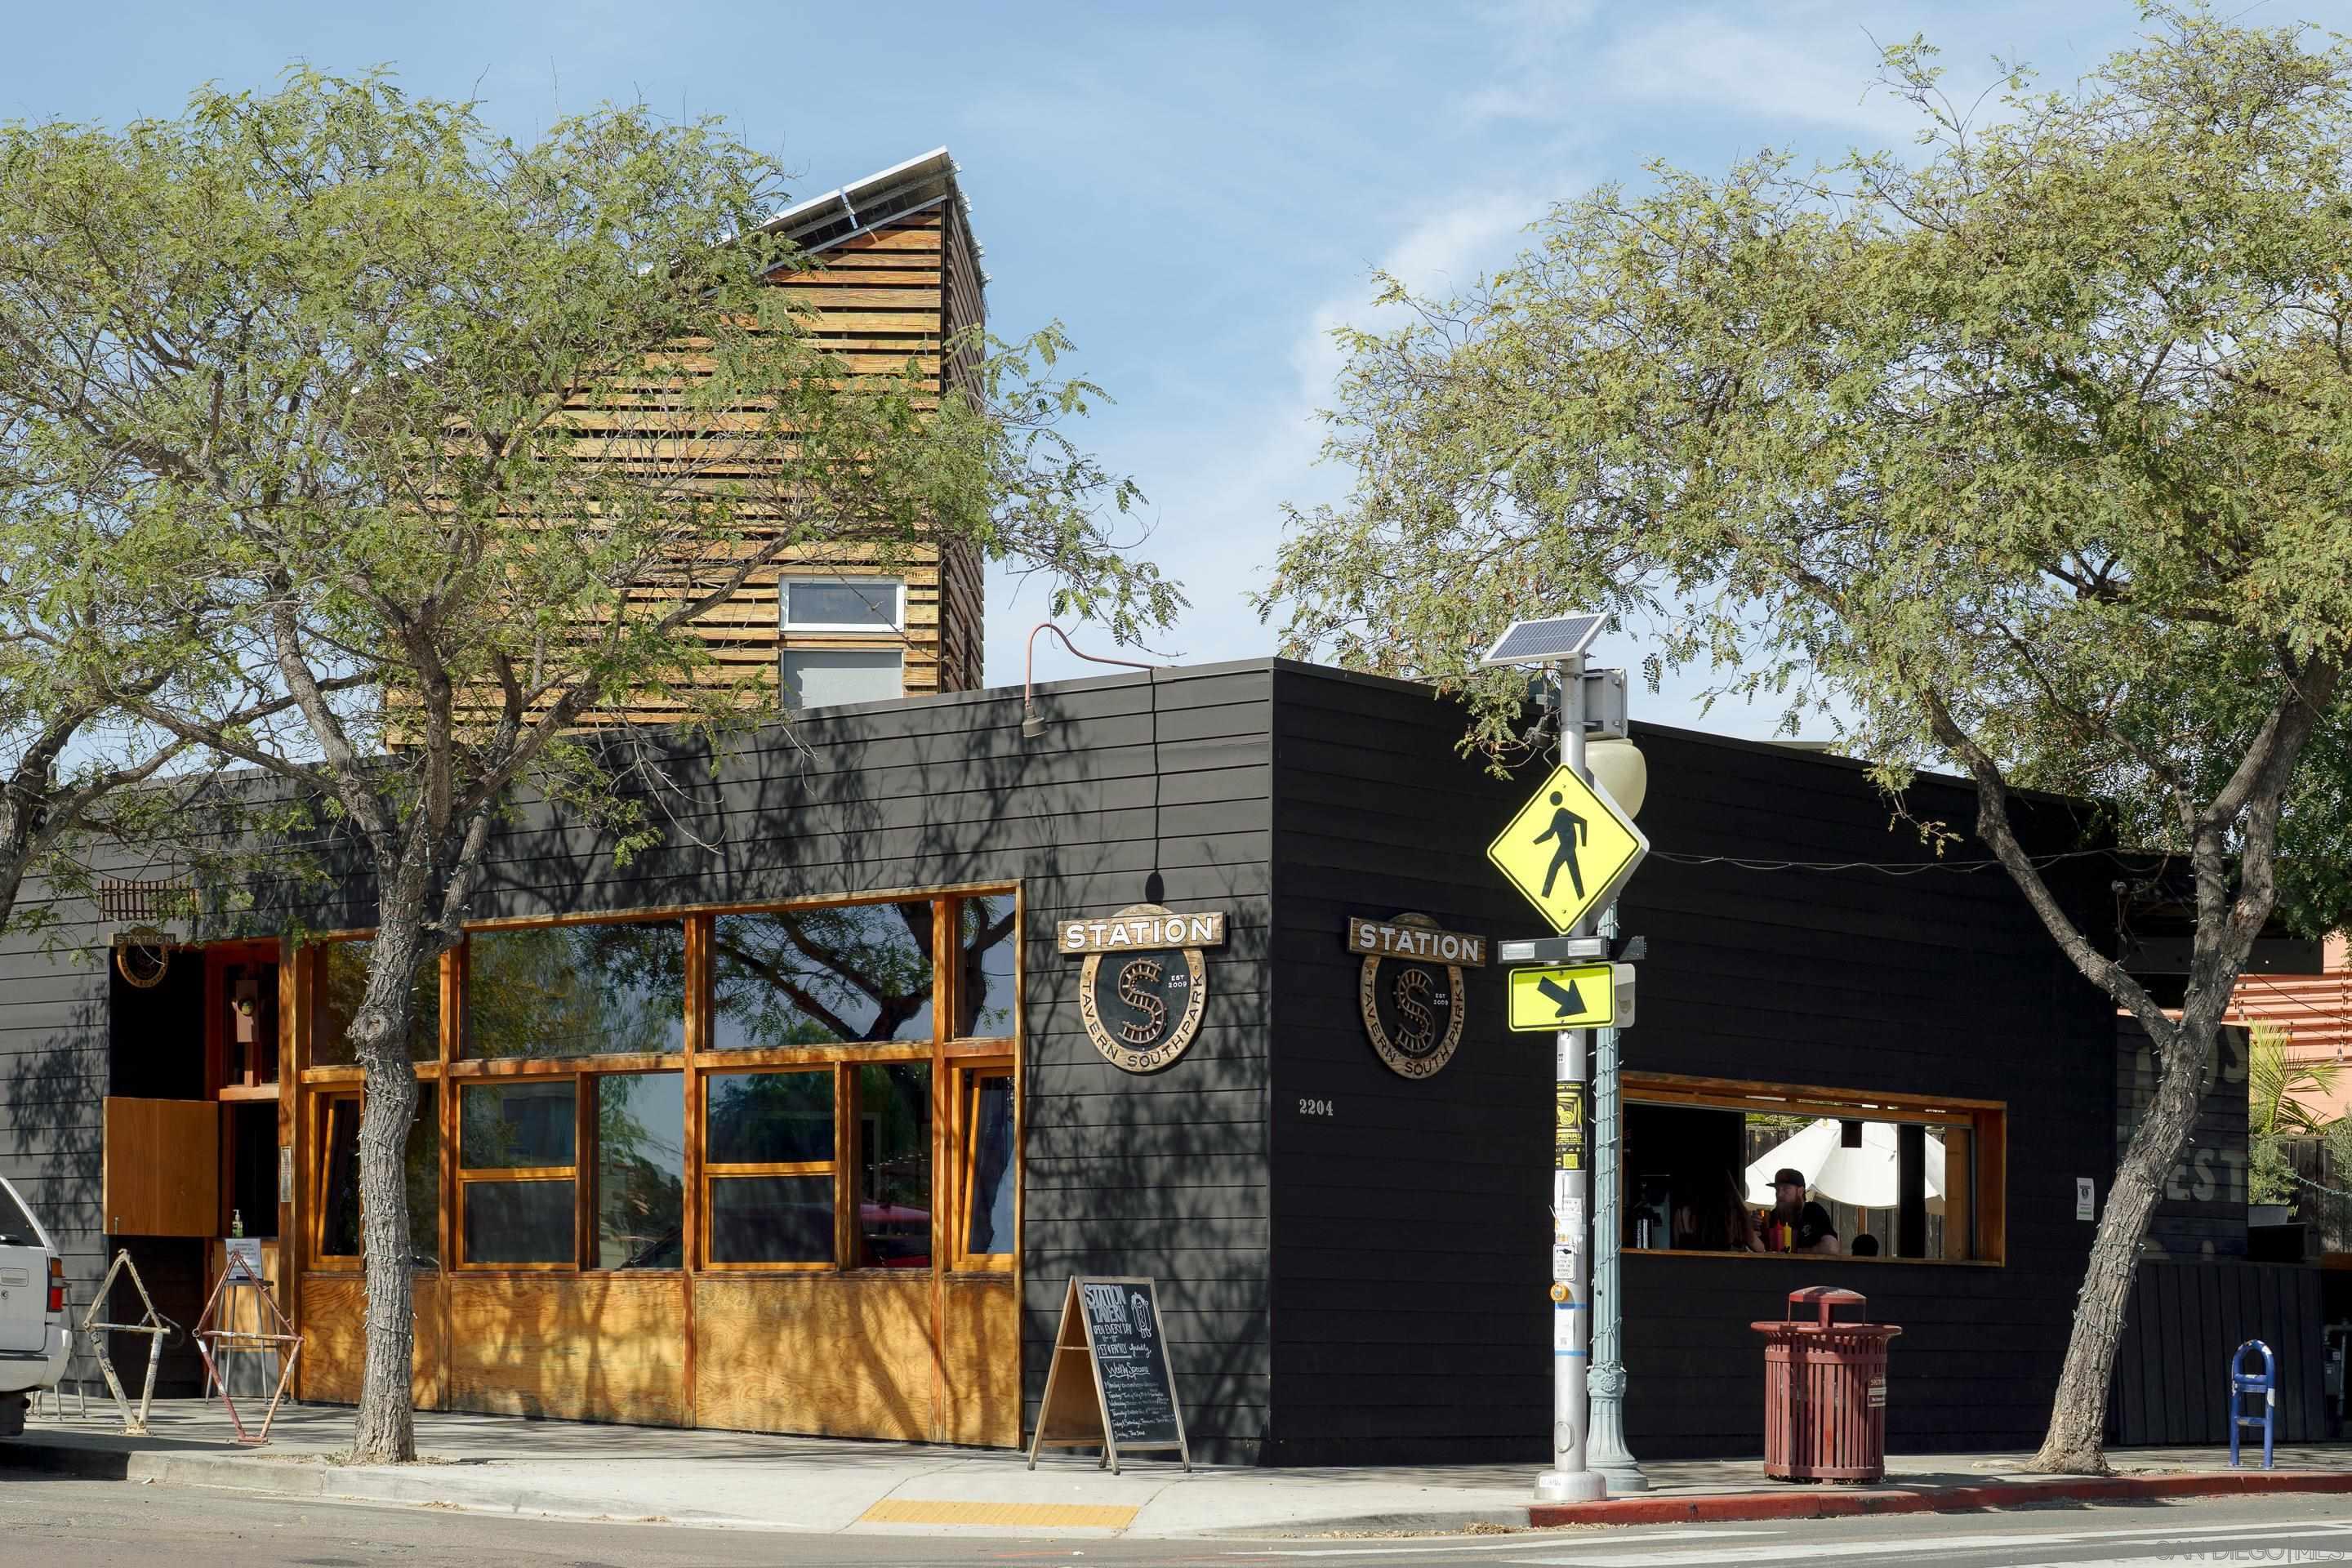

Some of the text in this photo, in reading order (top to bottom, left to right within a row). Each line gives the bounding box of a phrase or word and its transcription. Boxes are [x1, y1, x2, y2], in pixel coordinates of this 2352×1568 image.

[117, 935, 174, 945] STATION
[1066, 917, 1214, 949] STATION
[1359, 924, 1479, 962] STATION
[1082, 973, 1203, 1067] TAVERN SOUTH PARK
[1364, 981, 1463, 1076] TAVERN SOUTH PARK
[1299, 1098, 1334, 1116] 2204
[1085, 1285, 1126, 1308] STATION
[1094, 1305, 1127, 1323] TAVERN
[1105, 1324, 1122, 1334] EVERY
[1097, 1343, 1107, 1356] PET
